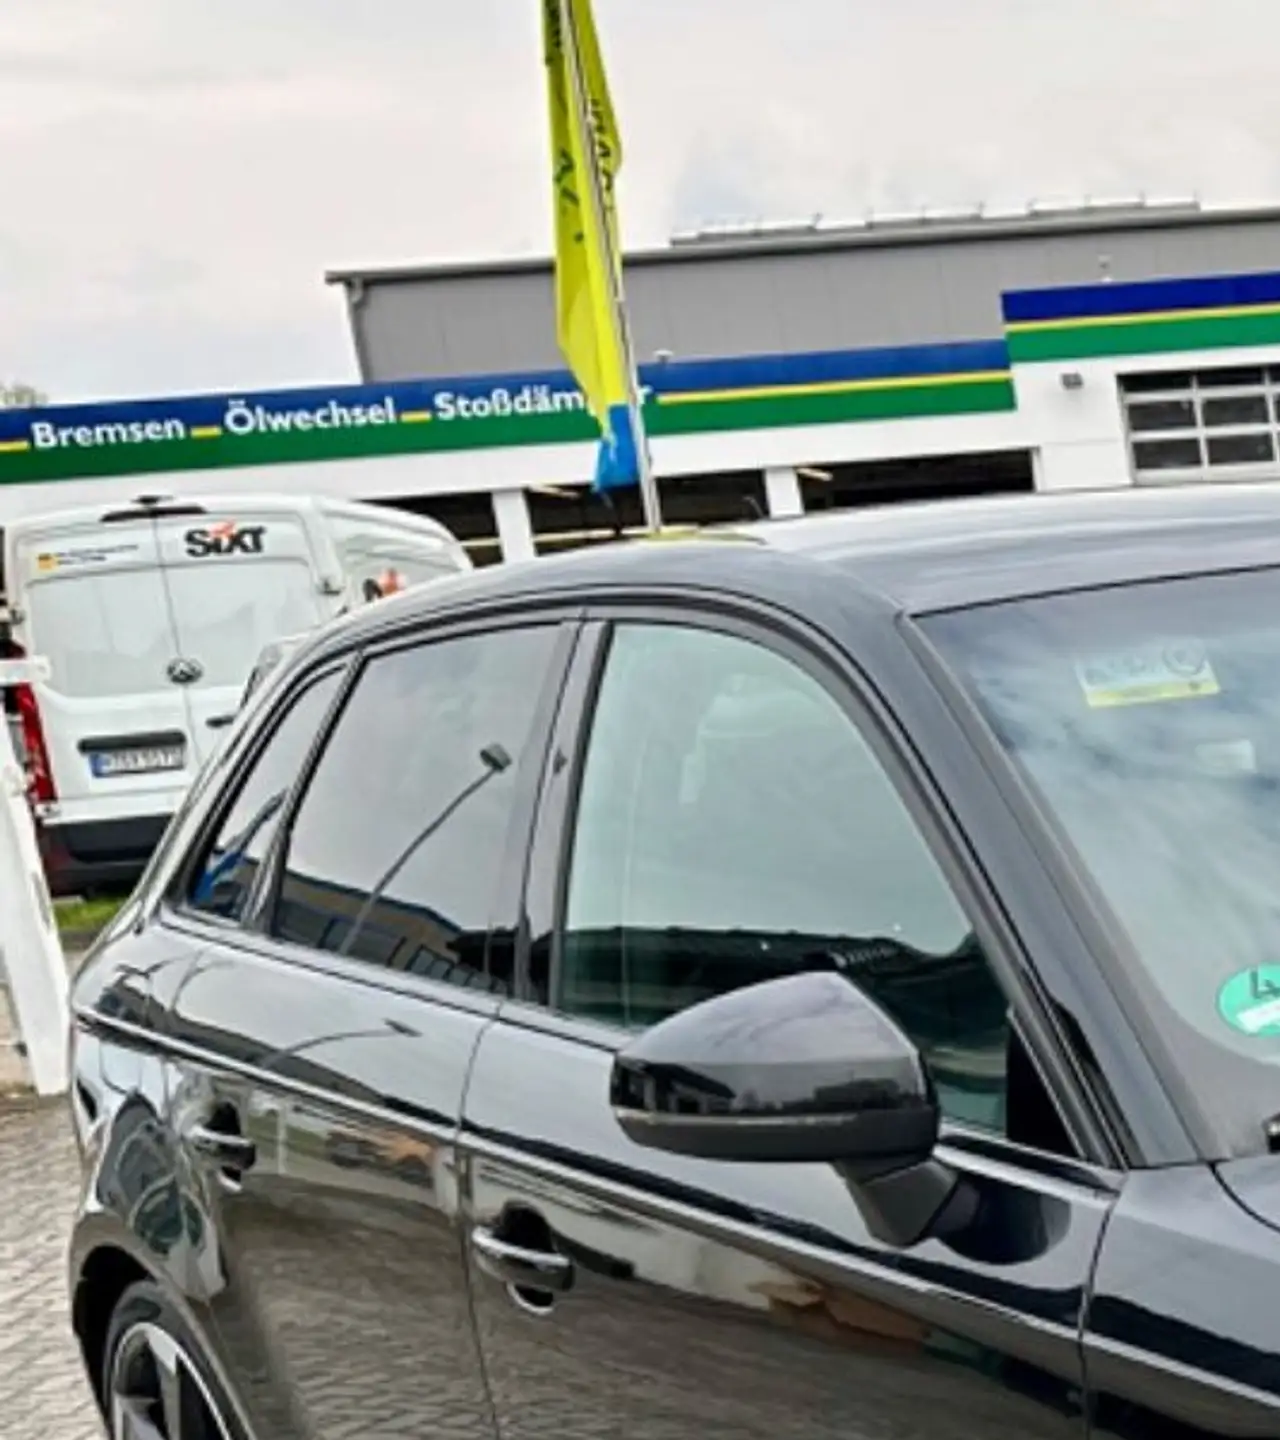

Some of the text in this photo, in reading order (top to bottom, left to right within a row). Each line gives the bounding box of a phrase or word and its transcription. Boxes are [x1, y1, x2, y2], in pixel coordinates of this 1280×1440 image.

[30, 417, 185, 449] Bremsen
[224, 397, 397, 435] Ölwechsel
[184, 520, 266, 558] SIXT
